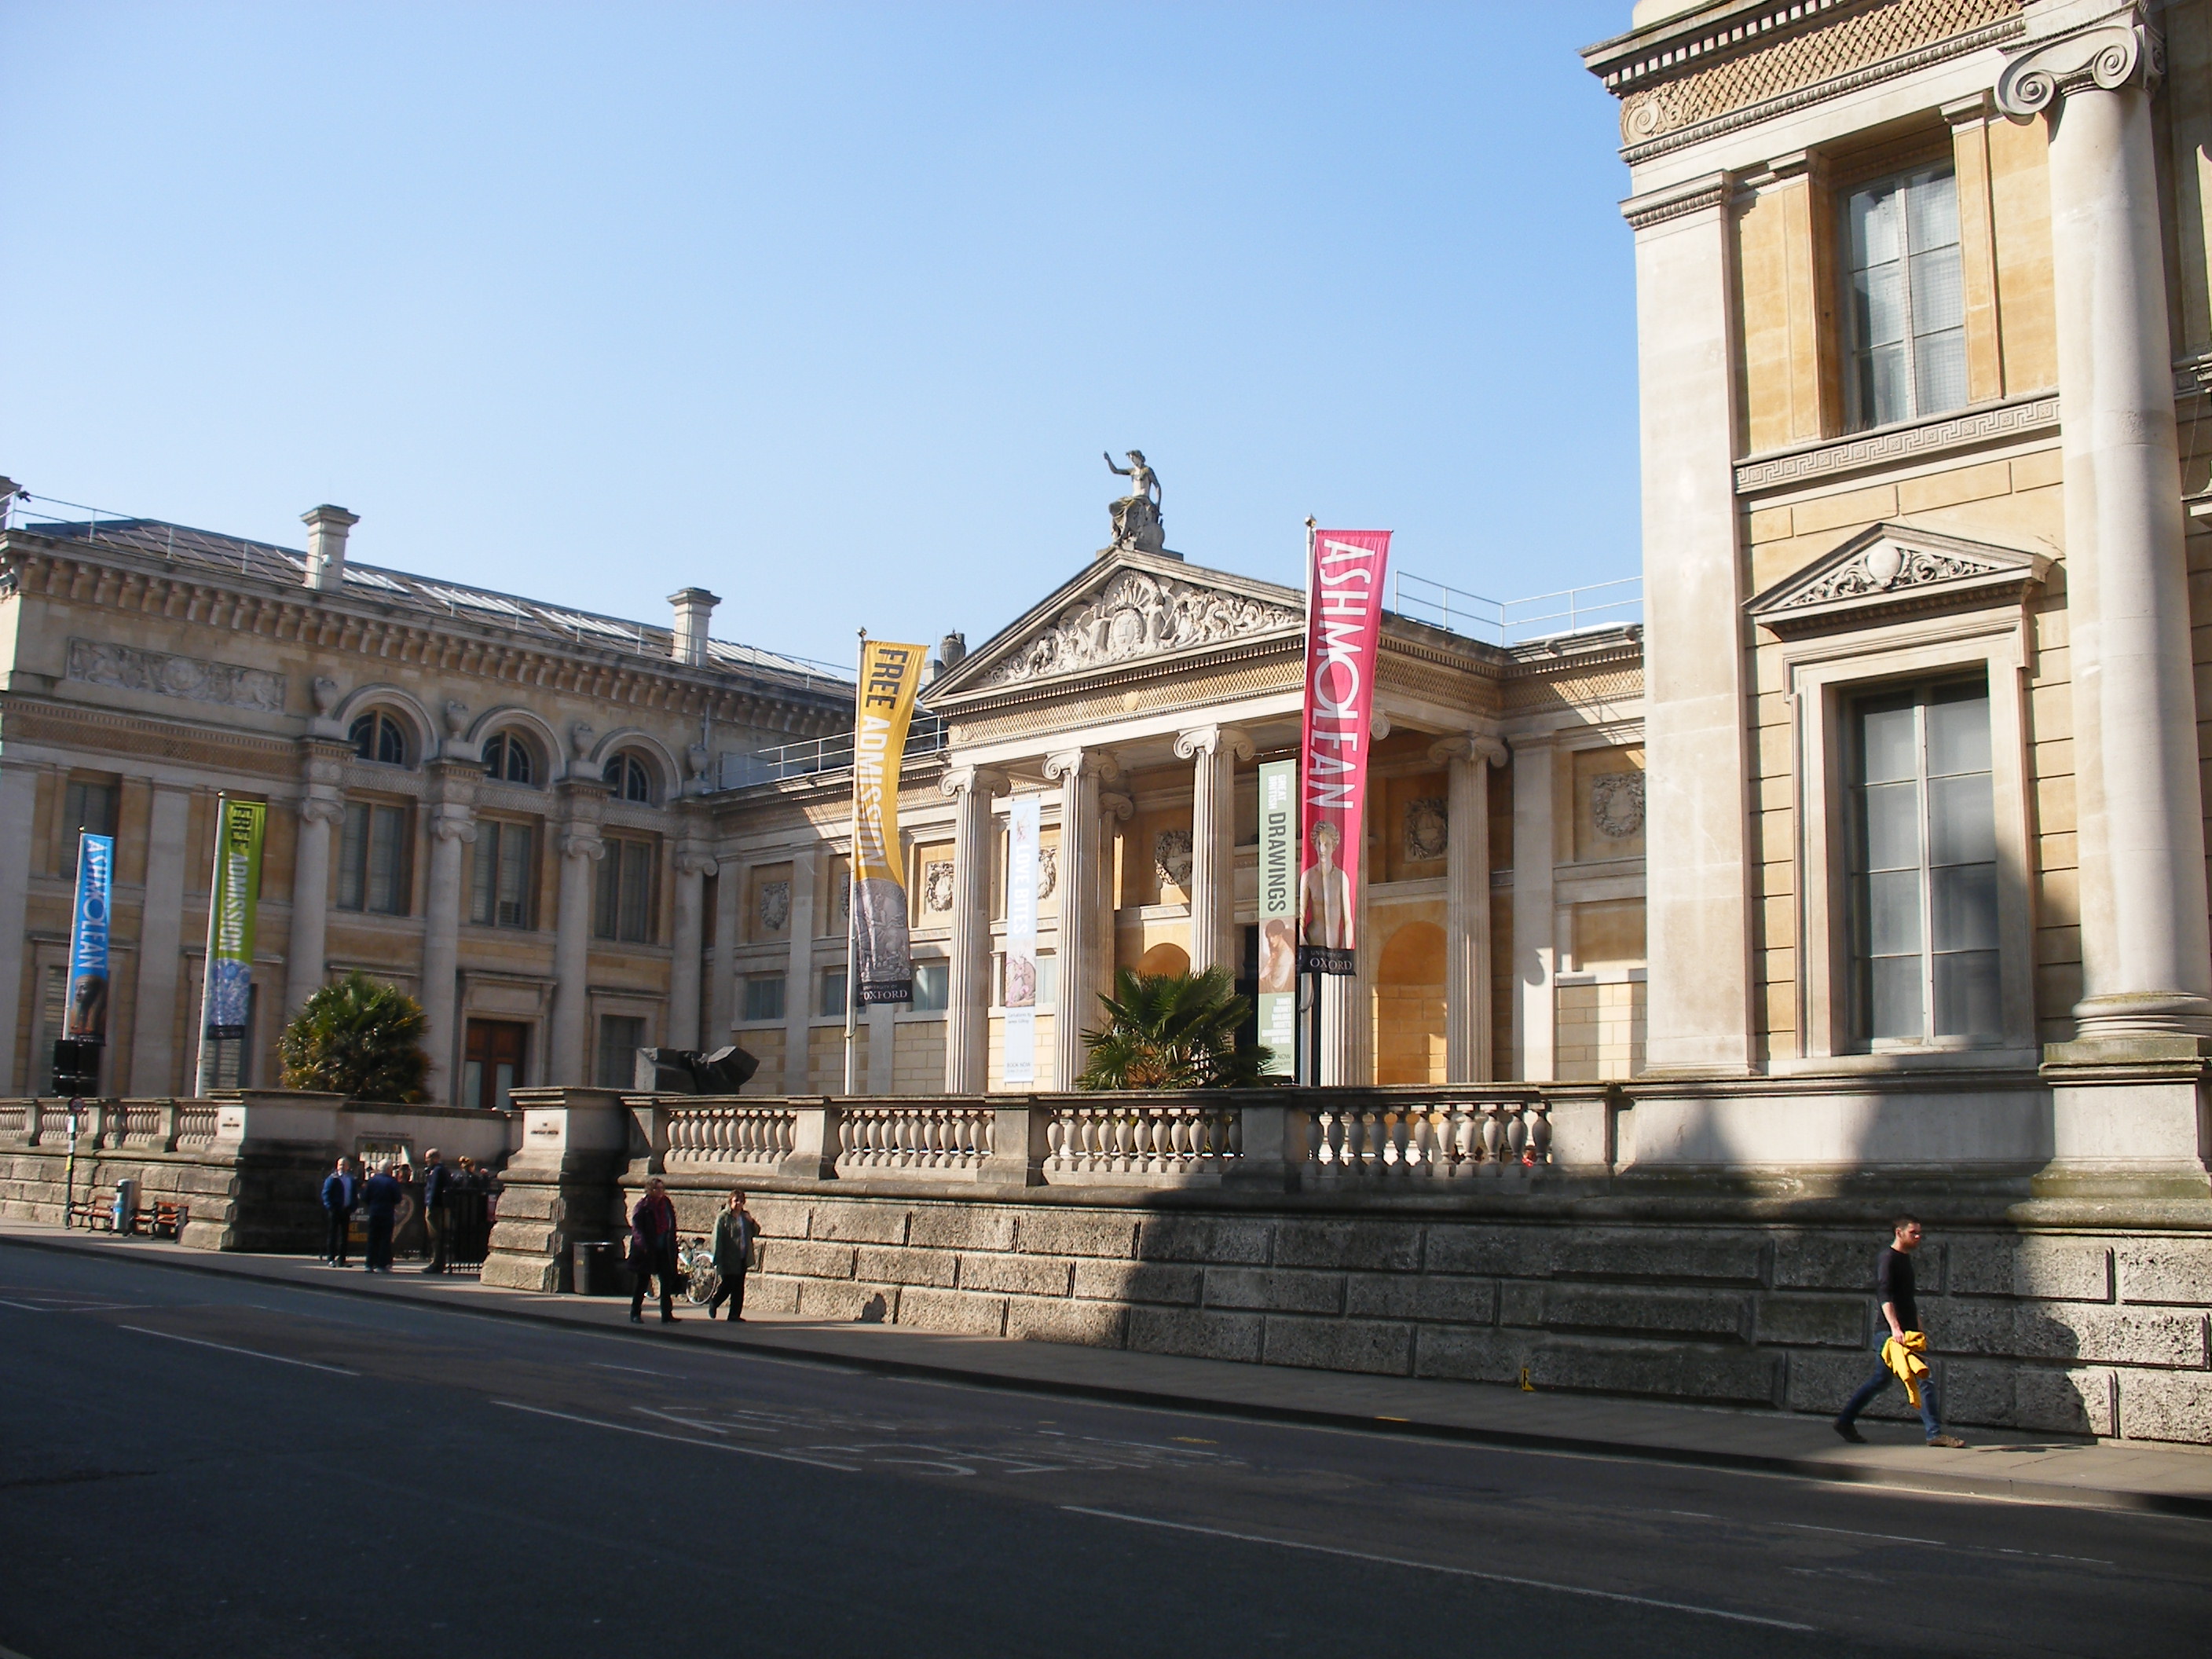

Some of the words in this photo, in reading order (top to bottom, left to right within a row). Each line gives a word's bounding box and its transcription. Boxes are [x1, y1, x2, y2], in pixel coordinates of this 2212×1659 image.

[866, 648, 908, 710] FREE
[1306, 539, 1376, 810] ASHMOLEAN
[857, 714, 892, 868] ADMISSION
[1268, 775, 1278, 809] BRITISH
[1278, 774, 1287, 801] GREAT
[231, 806, 254, 848] FREE
[1014, 844, 1031, 885] LOVE
[1268, 812, 1287, 911] DRAWINGS
[79, 839, 108, 969] ASHMOLEAN
[219, 851, 249, 953] ADMISSION
[1013, 888, 1030, 936] BITES
[863, 990, 908, 1001] OXFORD
